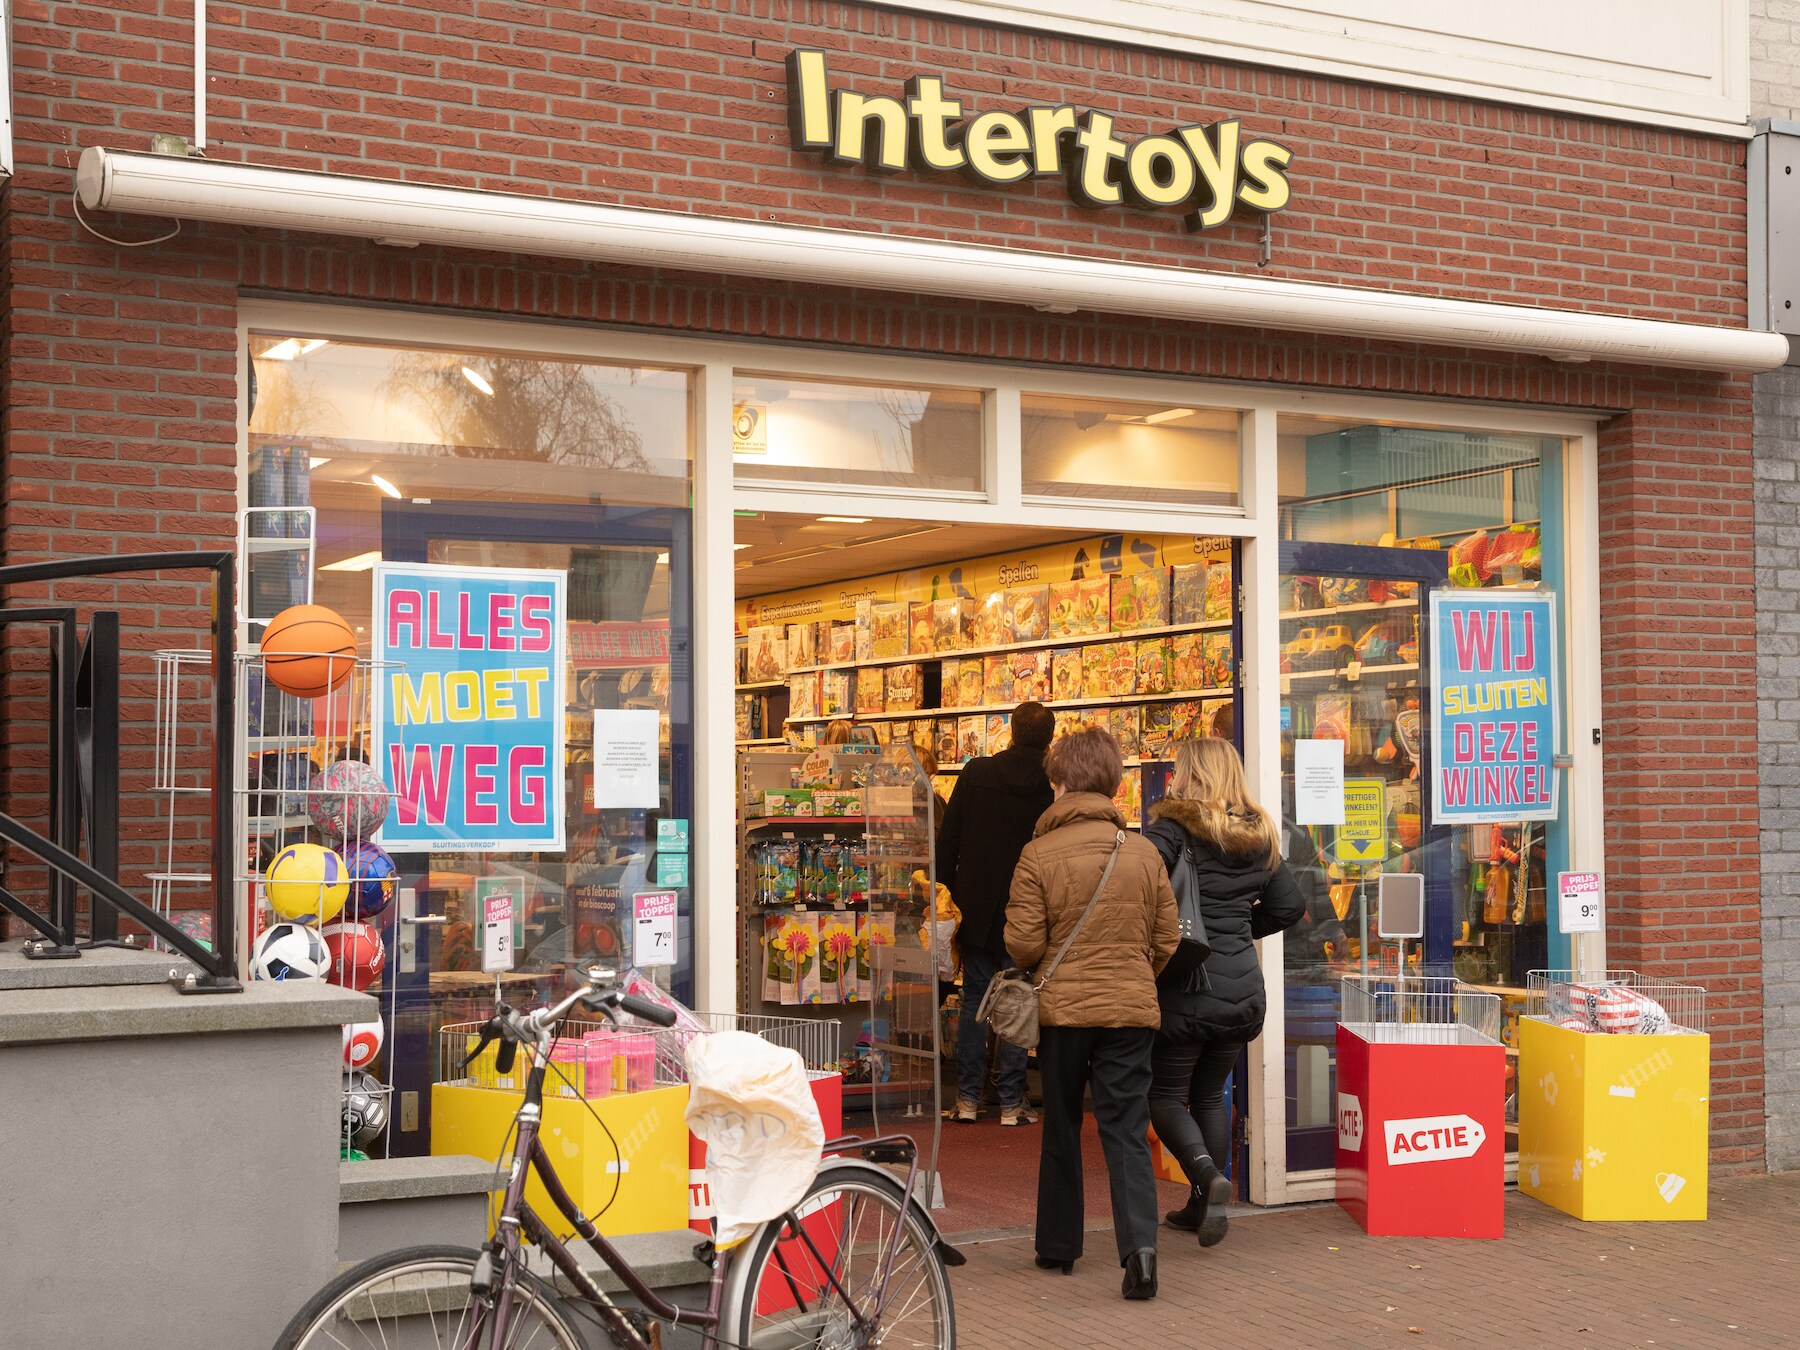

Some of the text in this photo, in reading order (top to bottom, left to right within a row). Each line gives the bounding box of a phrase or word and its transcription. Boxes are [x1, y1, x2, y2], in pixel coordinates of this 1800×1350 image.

[788, 48, 1294, 229] Intertoys
[999, 560, 1039, 587] Spellen
[387, 588, 552, 653] ALLES
[760, 599, 824, 624] Experimenteren
[571, 630, 622, 660] ALLES
[1450, 609, 1535, 673] WIJ
[391, 667, 550, 726] MOET
[1443, 676, 1548, 716] SLUITEN
[1453, 720, 1538, 764] DEZE
[388, 743, 548, 826] WEG
[1441, 764, 1551, 807] WINKEL
[1368, 819, 1379, 827] UW
[432, 840, 496, 849] SLUITINGSVERKOOP
[591, 884, 622, 898] februari
[1568, 874, 1595, 885] PRIJS
[487, 905, 512, 923] TOPPER
[490, 897, 509, 912] PRIJS
[582, 898, 589, 909] de
[589, 898, 616, 912] bioscoop
[643, 895, 670, 908] PRIJS
[1339, 1109, 1359, 1138] ACTIE
[1393, 1126, 1469, 1154] ACTIE
